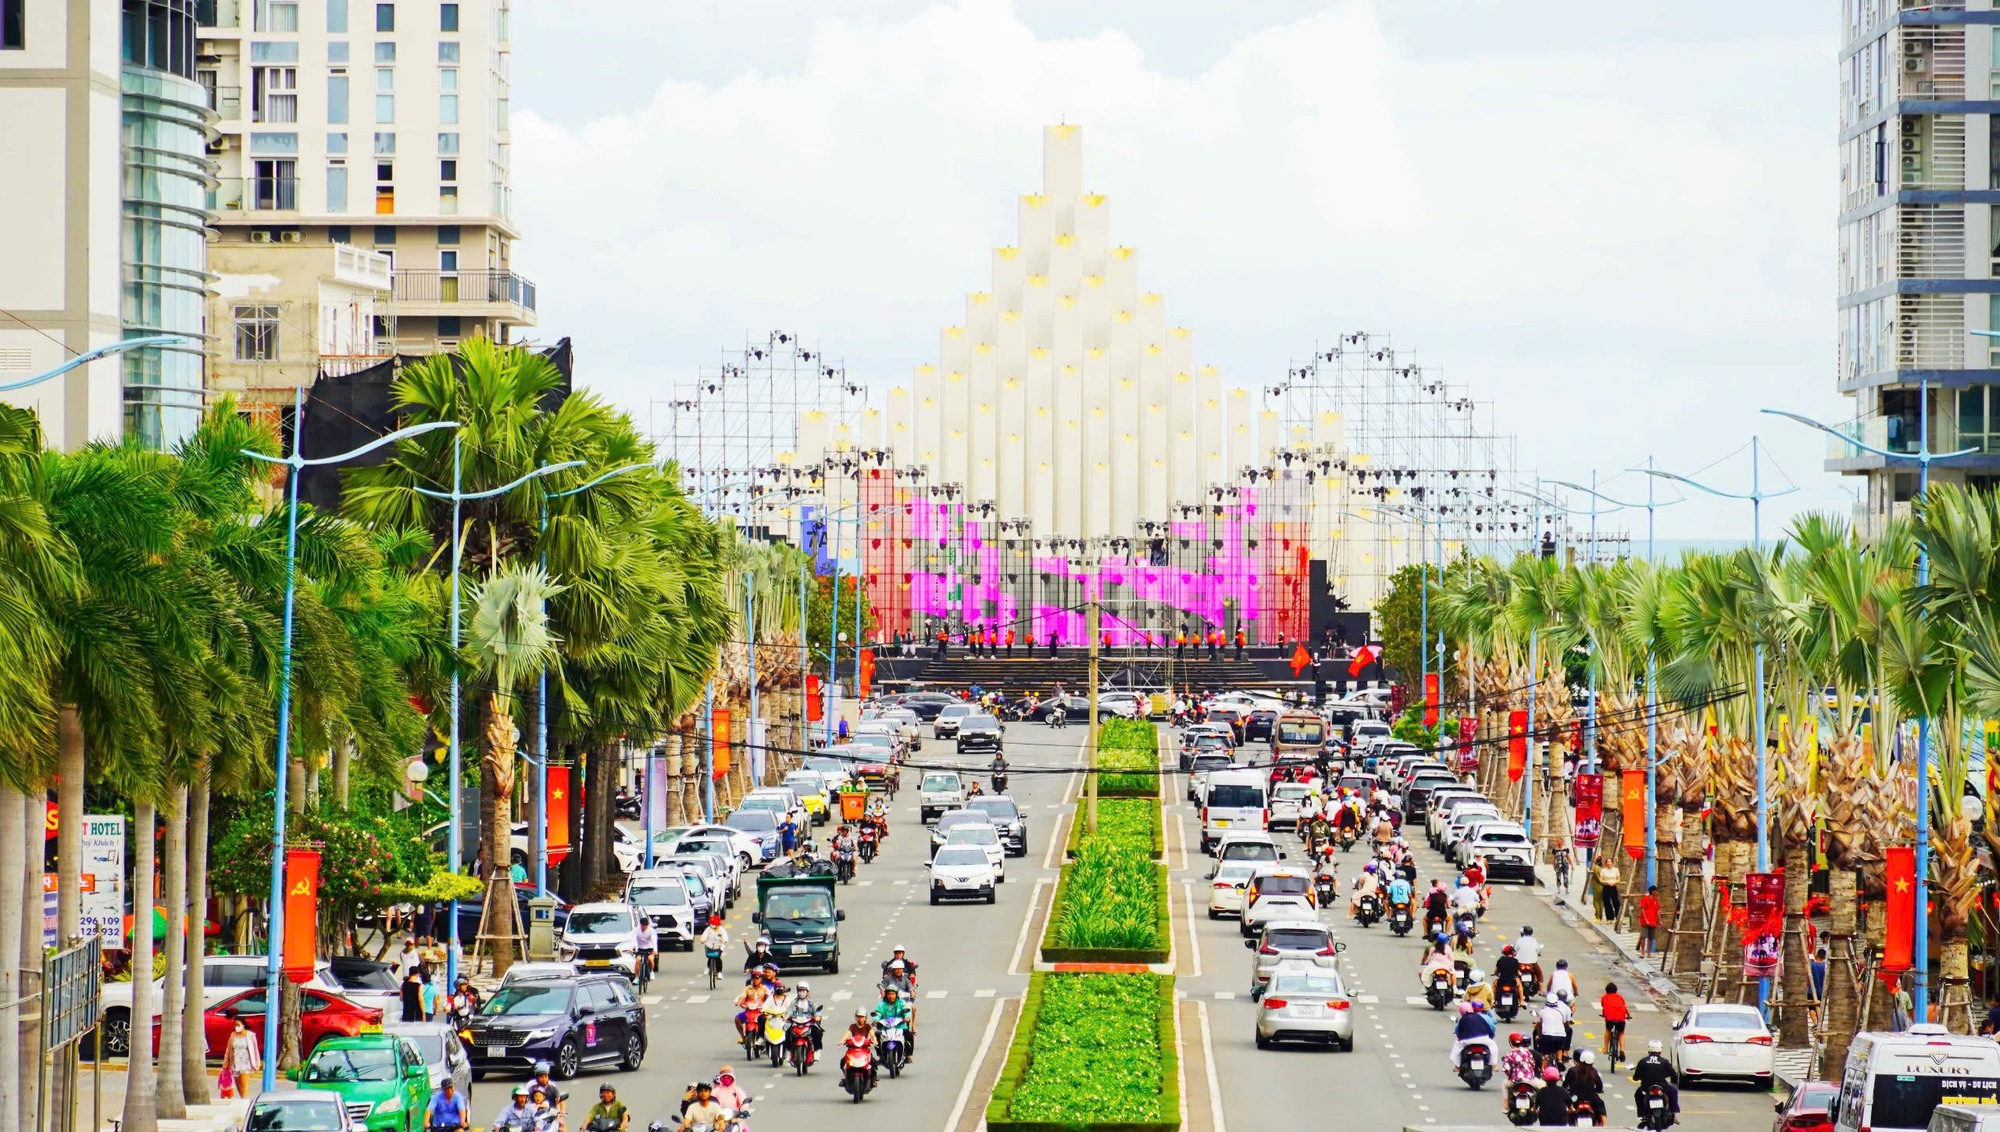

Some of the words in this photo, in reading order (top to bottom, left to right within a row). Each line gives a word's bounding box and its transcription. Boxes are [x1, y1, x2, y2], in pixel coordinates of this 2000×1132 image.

[91, 822, 122, 836] HOTEL
[1396, 885, 1404, 896] 15
[80, 917, 98, 925] 296
[102, 917, 120, 925] 109
[101, 928, 120, 936] 932
[1906, 1065, 1973, 1075] LUXURY
[1941, 1080, 1957, 1089] DỊCH
[1982, 1081, 1998, 1090] LỊCH
